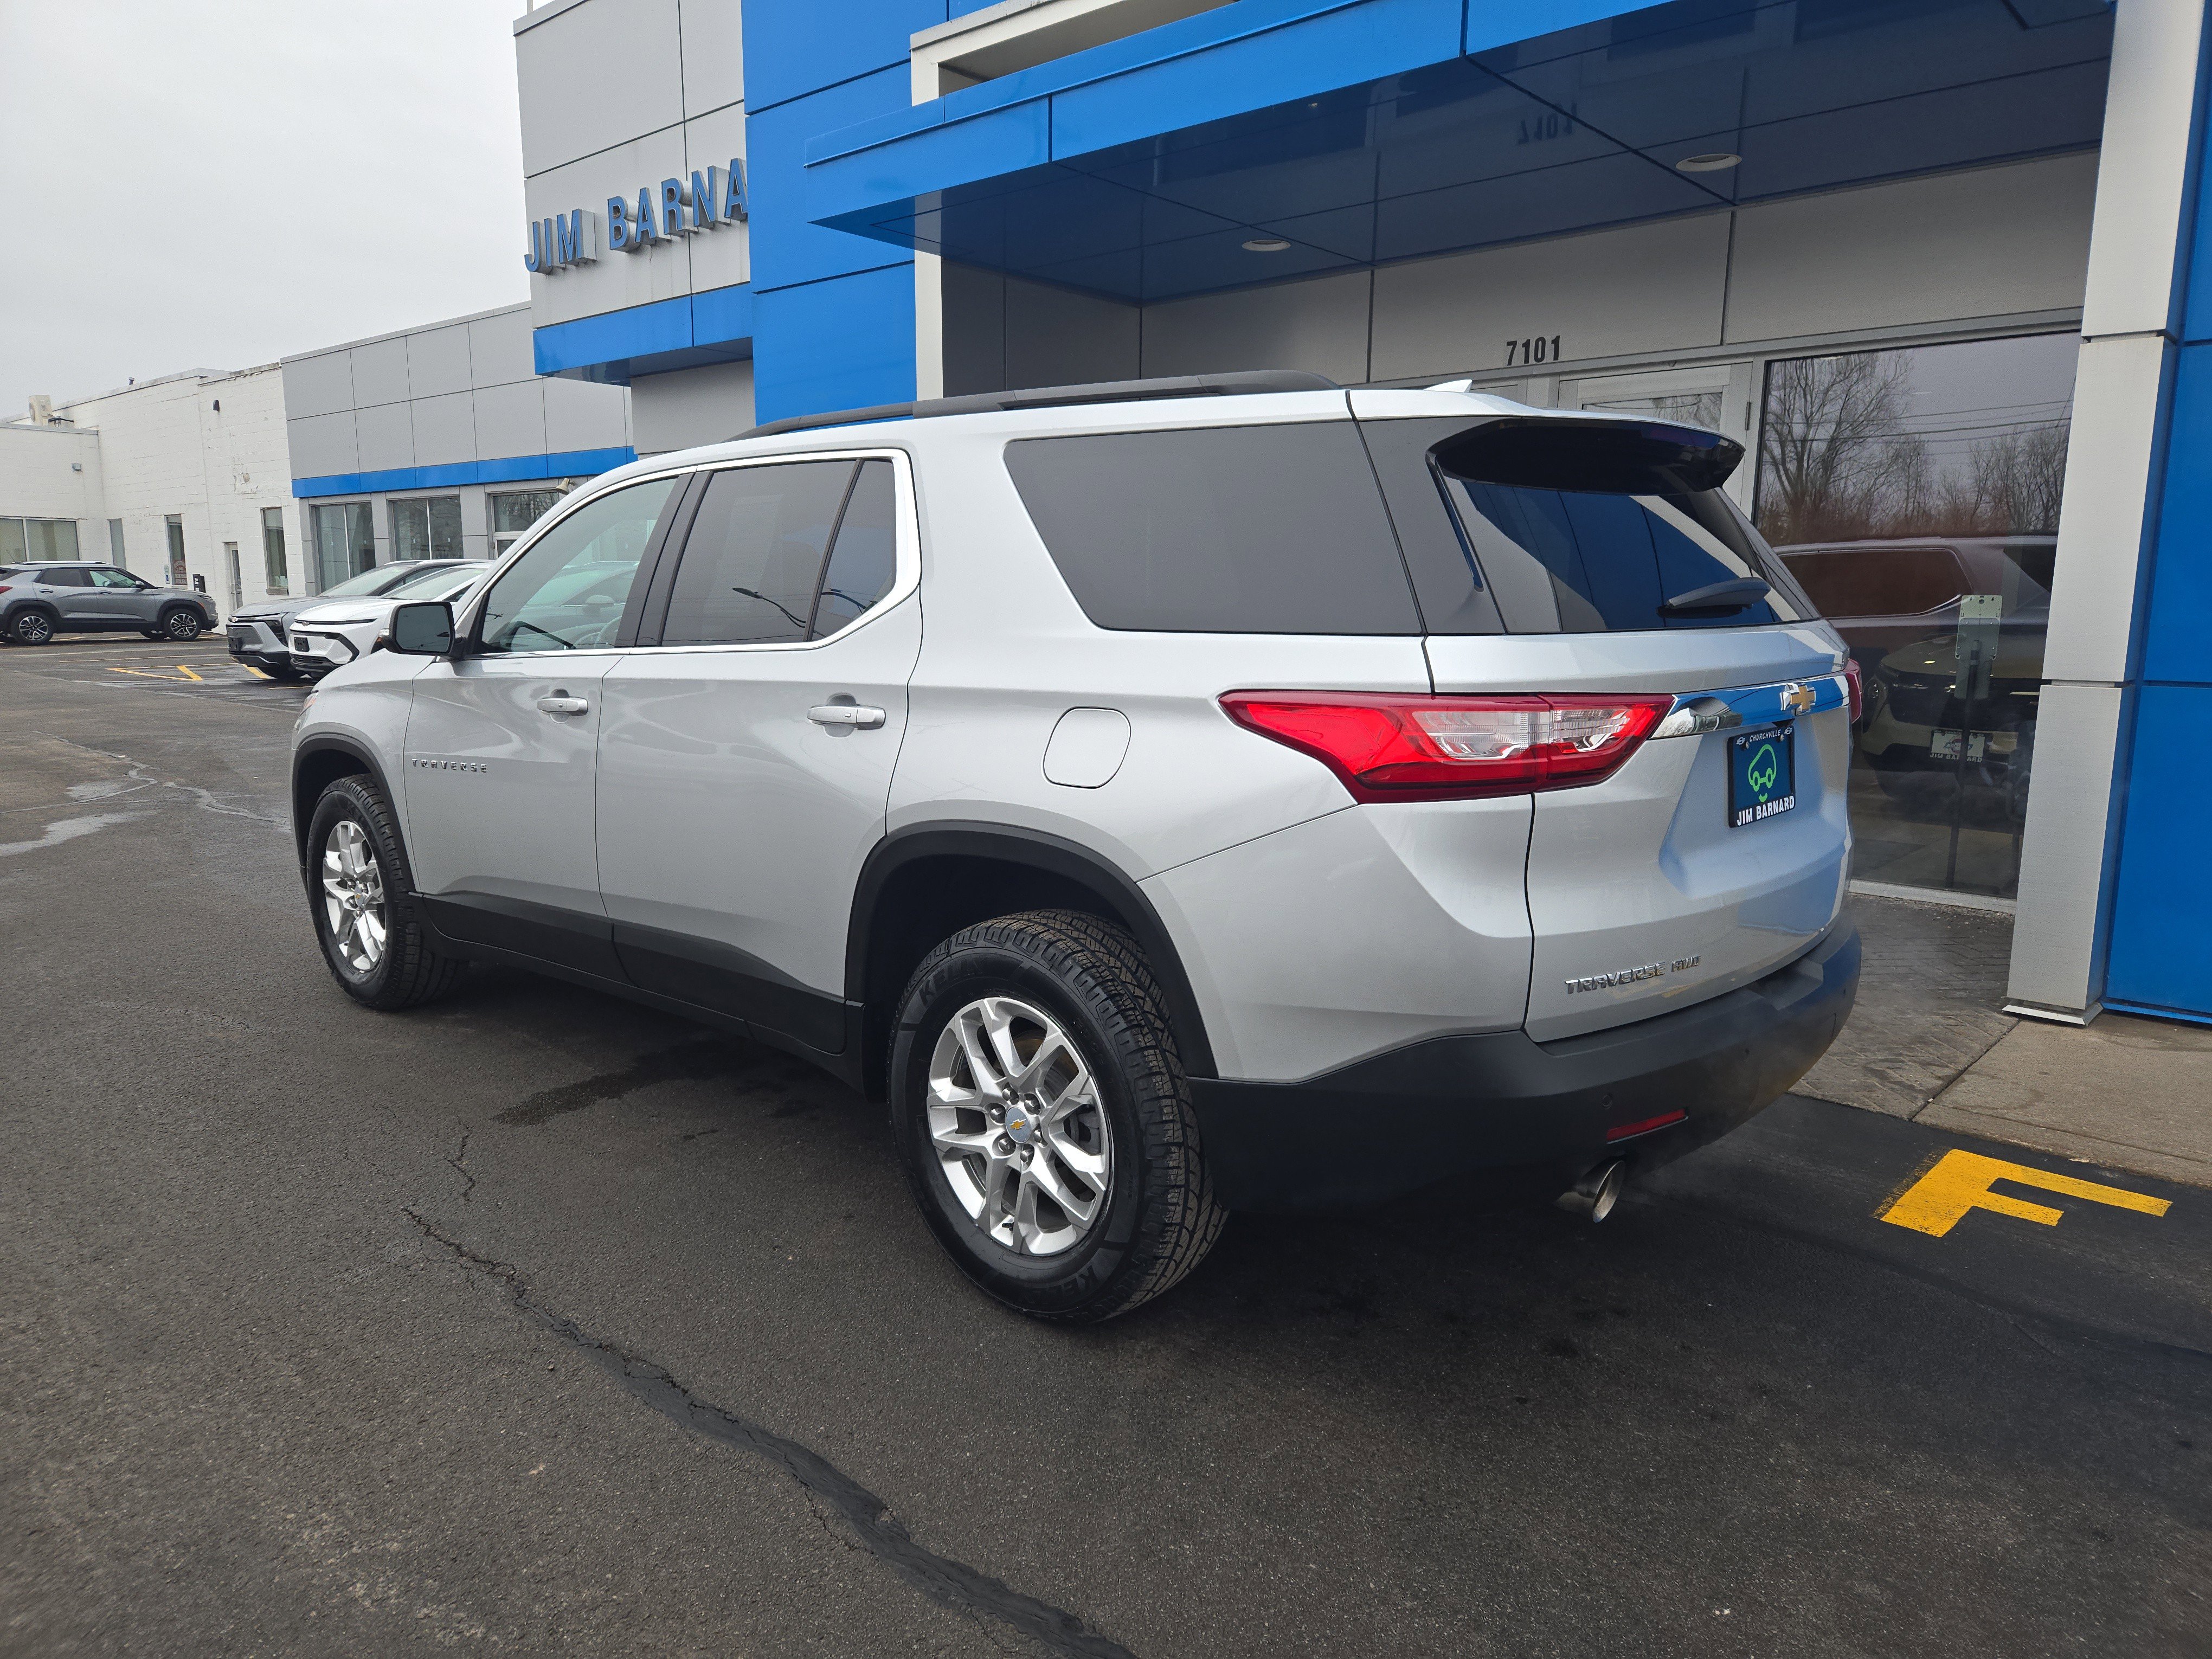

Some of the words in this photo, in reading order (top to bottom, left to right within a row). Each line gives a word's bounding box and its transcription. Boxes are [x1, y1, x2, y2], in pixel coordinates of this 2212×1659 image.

[524, 208, 589, 273] JIM
[1506, 335, 1561, 366] 7101
[1749, 729, 1782, 742] CHURCHVILLE
[411, 758, 487, 773] TRAVERSE
[1737, 808, 1753, 826] JIM
[1756, 795, 1795, 820] BARNARD
[1564, 961, 1666, 994] TRAVERSE
[1671, 955, 1701, 973] AWD
[1877, 1148, 2174, 1238] F
